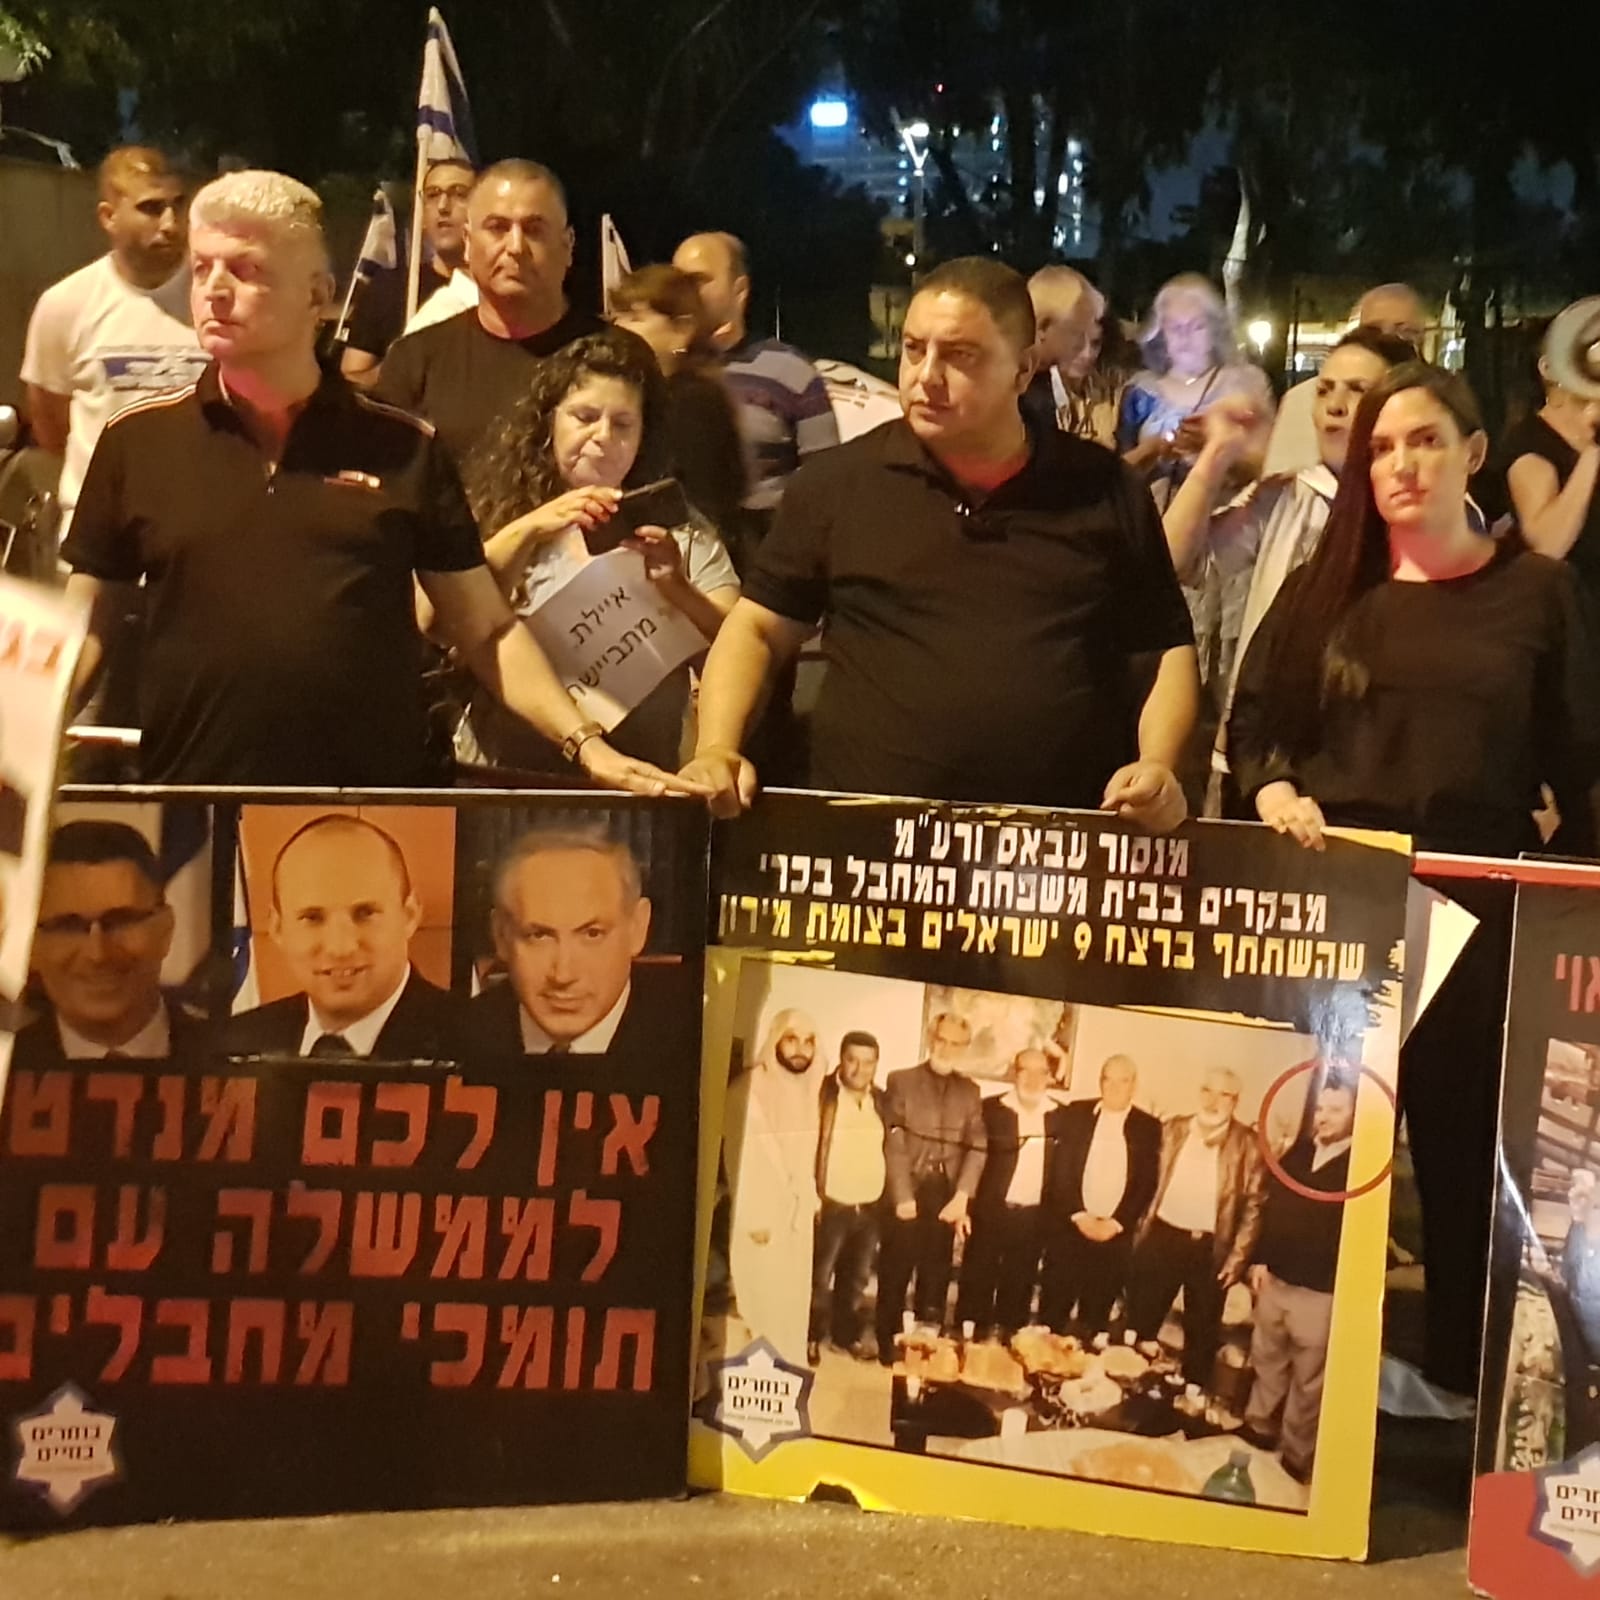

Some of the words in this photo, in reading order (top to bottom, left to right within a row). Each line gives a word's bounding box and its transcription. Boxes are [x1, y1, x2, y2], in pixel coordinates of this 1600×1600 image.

[569, 586, 631, 644] איילת
[996, 825, 1088, 870] עבאס
[1099, 831, 1189, 877] מנסור
[760, 853, 833, 897] בכרי
[847, 855, 957, 905] המחבל
[968, 868, 1088, 916] משפחת
[717, 893, 792, 939] מירון
[806, 901, 907, 947] בצומת
[1100, 879, 1184, 923] בבית
[1199, 886, 1328, 935] מבקרים
[921, 908, 1059, 958] ישראלים
[1073, 921, 1093, 961] 9
[1104, 923, 1195, 970] ברצח
[1213, 932, 1366, 981] שהשתתף
[9, 1070, 258, 1163] מנדט
[302, 1075, 498, 1169] לכם
[537, 1090, 660, 1187] אין
[34, 1184, 166, 1271] עם
[212, 1180, 621, 1282] לממשלה
[401, 1302, 656, 1391] תומכי
